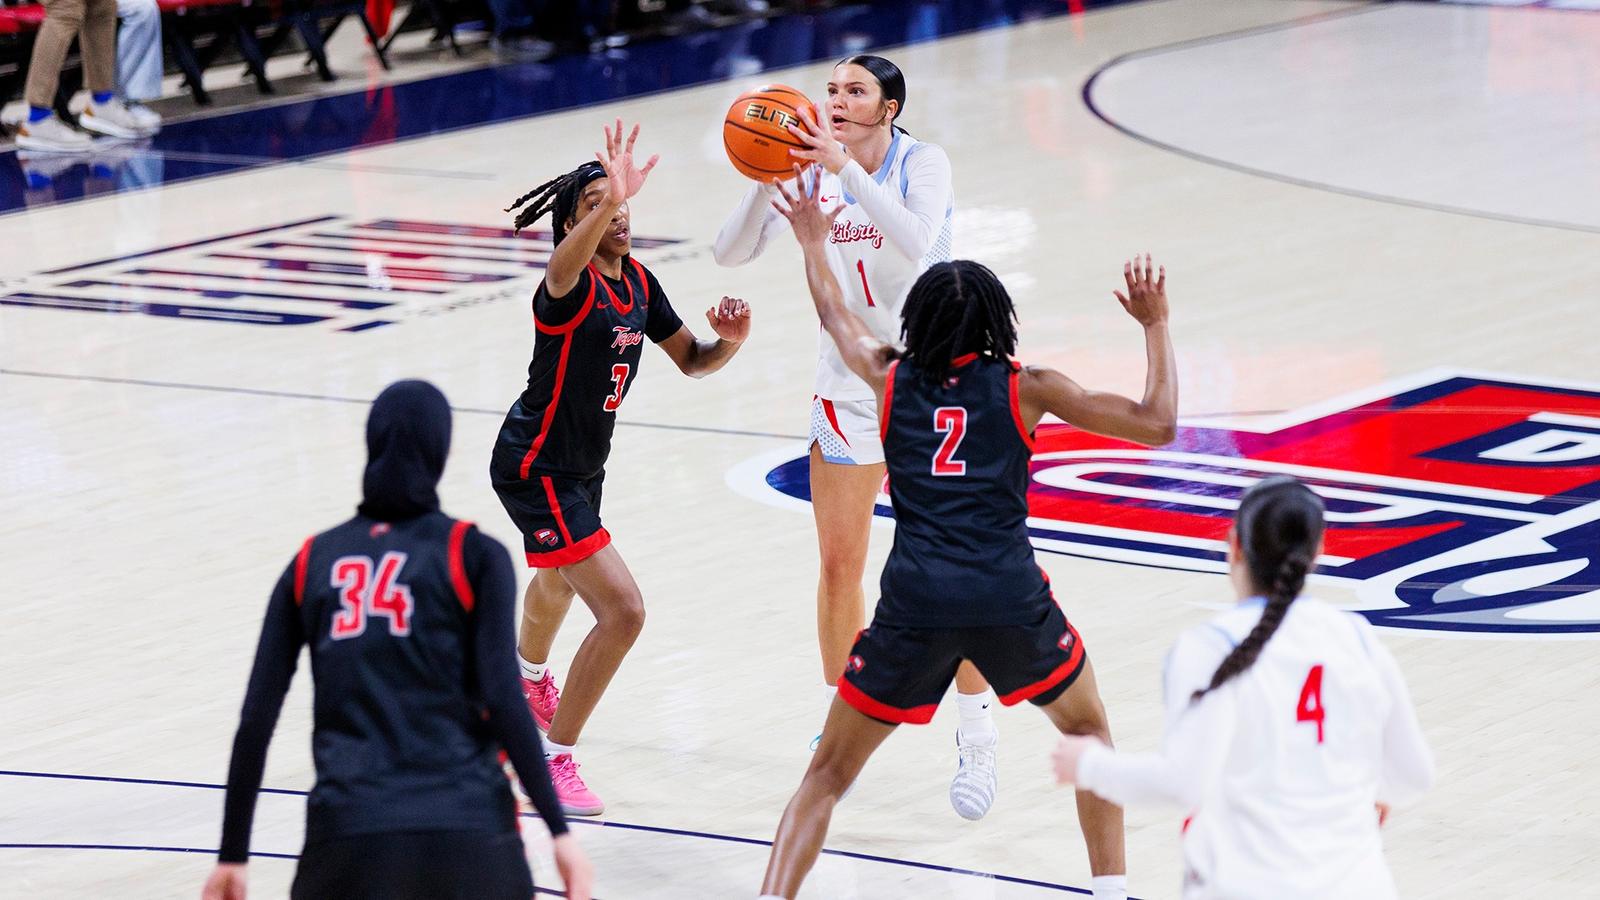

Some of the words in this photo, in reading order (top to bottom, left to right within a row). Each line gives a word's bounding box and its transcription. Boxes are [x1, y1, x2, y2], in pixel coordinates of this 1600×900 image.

[744, 102, 801, 130] ELITE
[829, 219, 883, 249] Liberty
[856, 258, 876, 307] 1
[603, 363, 630, 412] 3
[931, 406, 967, 476] 2
[330, 550, 415, 641] 34
[1296, 664, 1325, 744] 4
